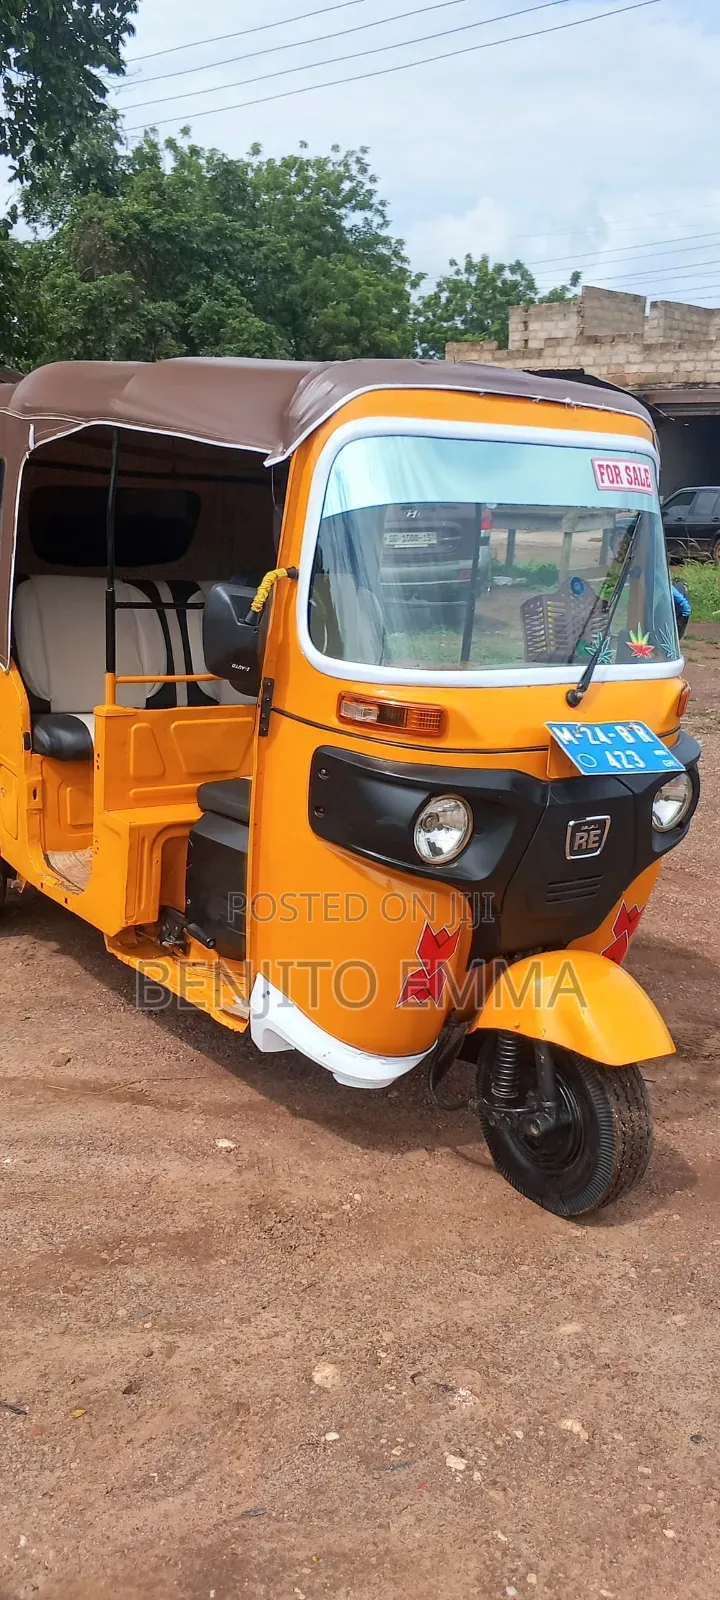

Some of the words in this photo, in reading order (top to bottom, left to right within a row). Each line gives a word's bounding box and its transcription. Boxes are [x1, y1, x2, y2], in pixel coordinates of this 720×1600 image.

[597, 463, 623, 485] FOR
[625, 465, 652, 489] SALE
[604, 749, 647, 769] 423
[573, 829, 602, 851] RE
